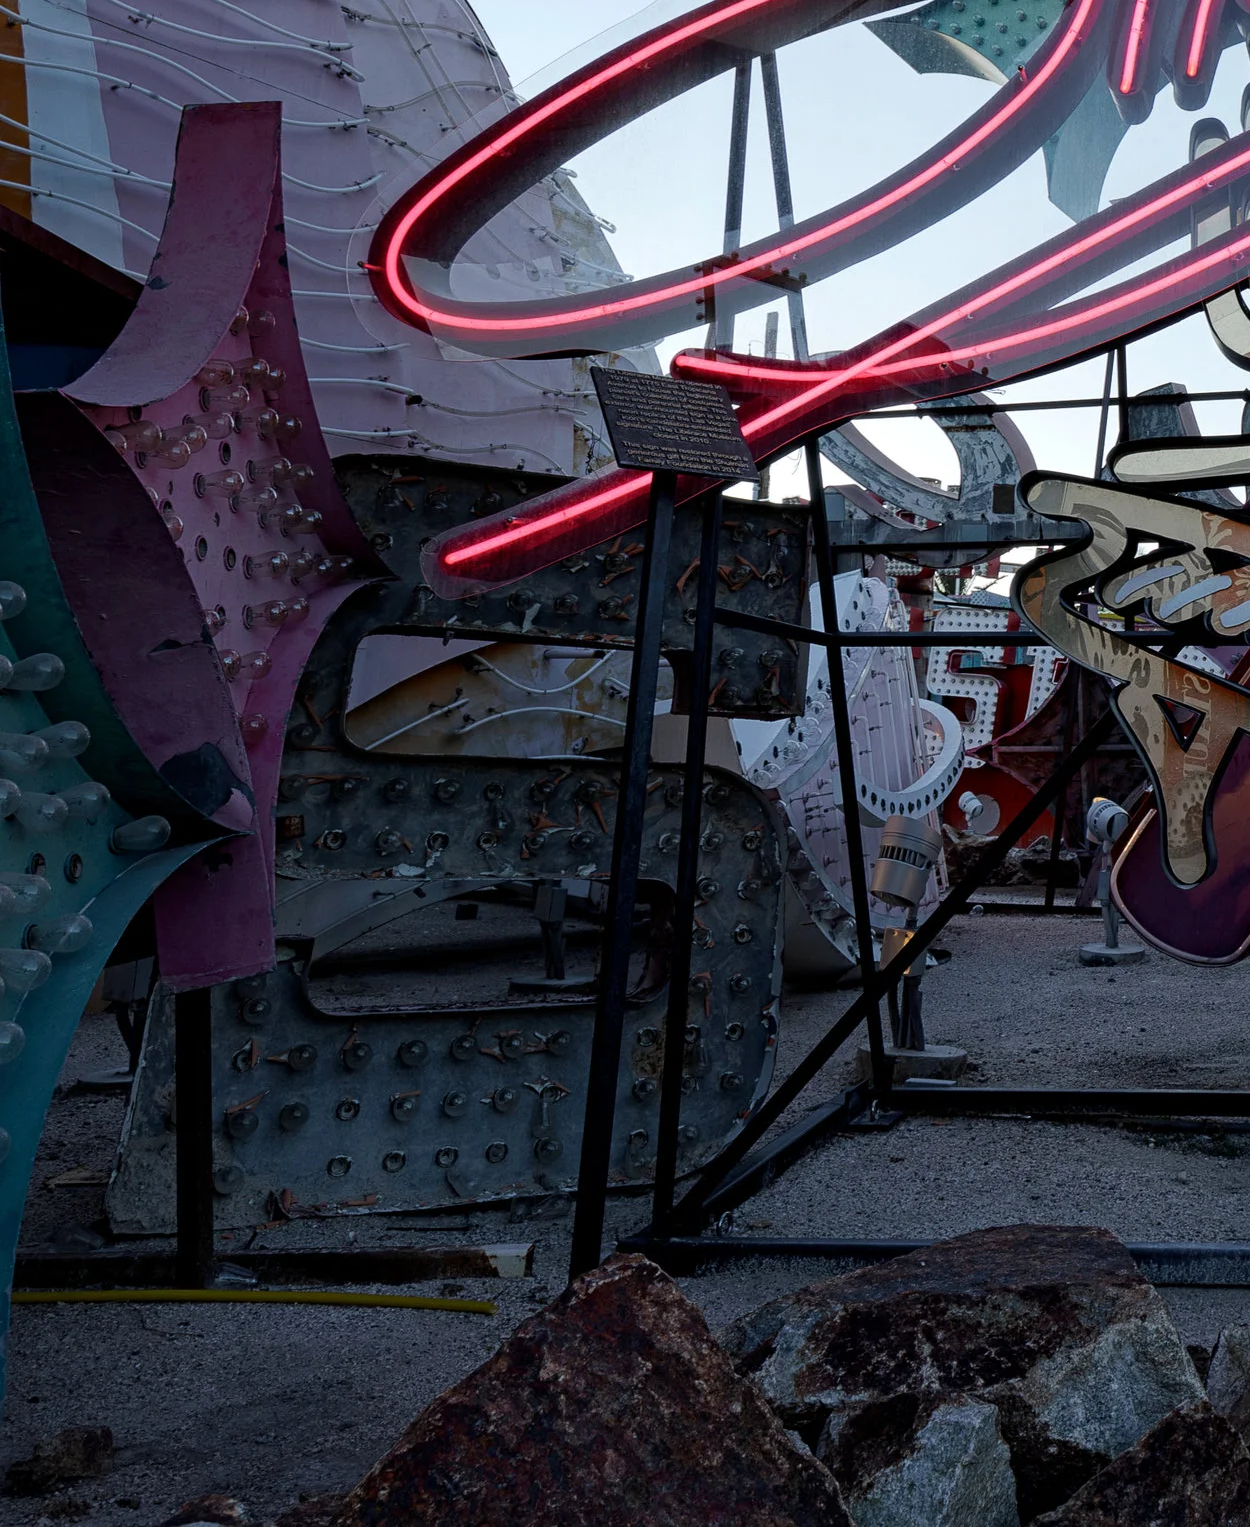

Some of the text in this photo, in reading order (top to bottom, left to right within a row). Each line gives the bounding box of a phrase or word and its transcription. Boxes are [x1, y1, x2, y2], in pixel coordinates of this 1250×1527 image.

[617, 370, 650, 378] Liberace
[651, 375, 684, 383] Museum
[684, 380, 713, 388] opened
[606, 380, 637, 388] Avenue
[686, 392, 723, 402] legendary
[679, 385, 717, 395] Tropicana
[641, 391, 679, 401] collection
[603, 399, 634, 407] exterior
[646, 399, 681, 408] personal
[639, 410, 666, 419] replica
[705, 419, 731, 427] Vegas
[652, 432, 679, 440] closed
[673, 428, 707, 437] Liberace
[707, 432, 742, 441] Museum
[626, 449, 666, 459] generous
[641, 443, 659, 451] sign
[677, 447, 711, 456] restored
[711, 452, 742, 461] through
[636, 456, 665, 465] Family
[666, 459, 711, 469] Foundation
